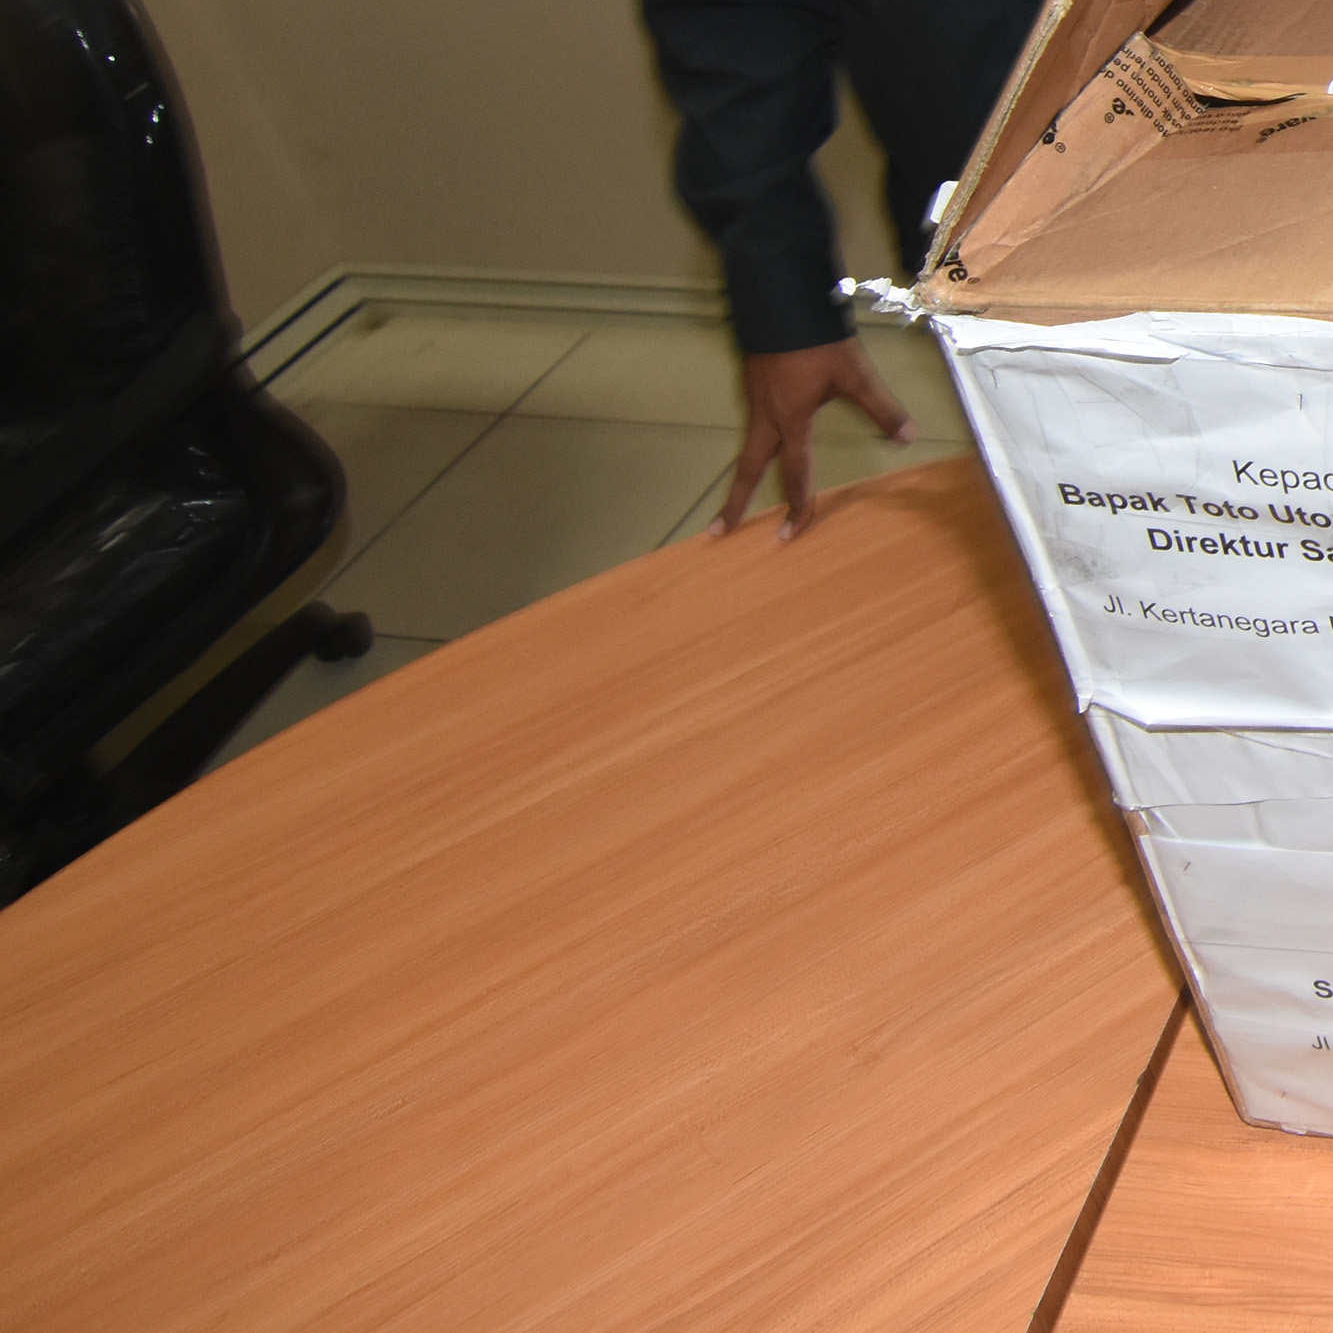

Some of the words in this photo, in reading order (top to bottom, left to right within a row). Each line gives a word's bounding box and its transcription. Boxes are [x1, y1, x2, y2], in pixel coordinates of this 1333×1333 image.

[1131, 72, 1162, 107] mohon
[1147, 68, 1172, 99] tanda
[1057, 481, 1170, 516] Bapak
[1176, 493, 1260, 523] Toto
[1147, 526, 1290, 562] Direktur
[1103, 593, 1133, 618] Jl.
[1140, 599, 1321, 638] Kertanegara
